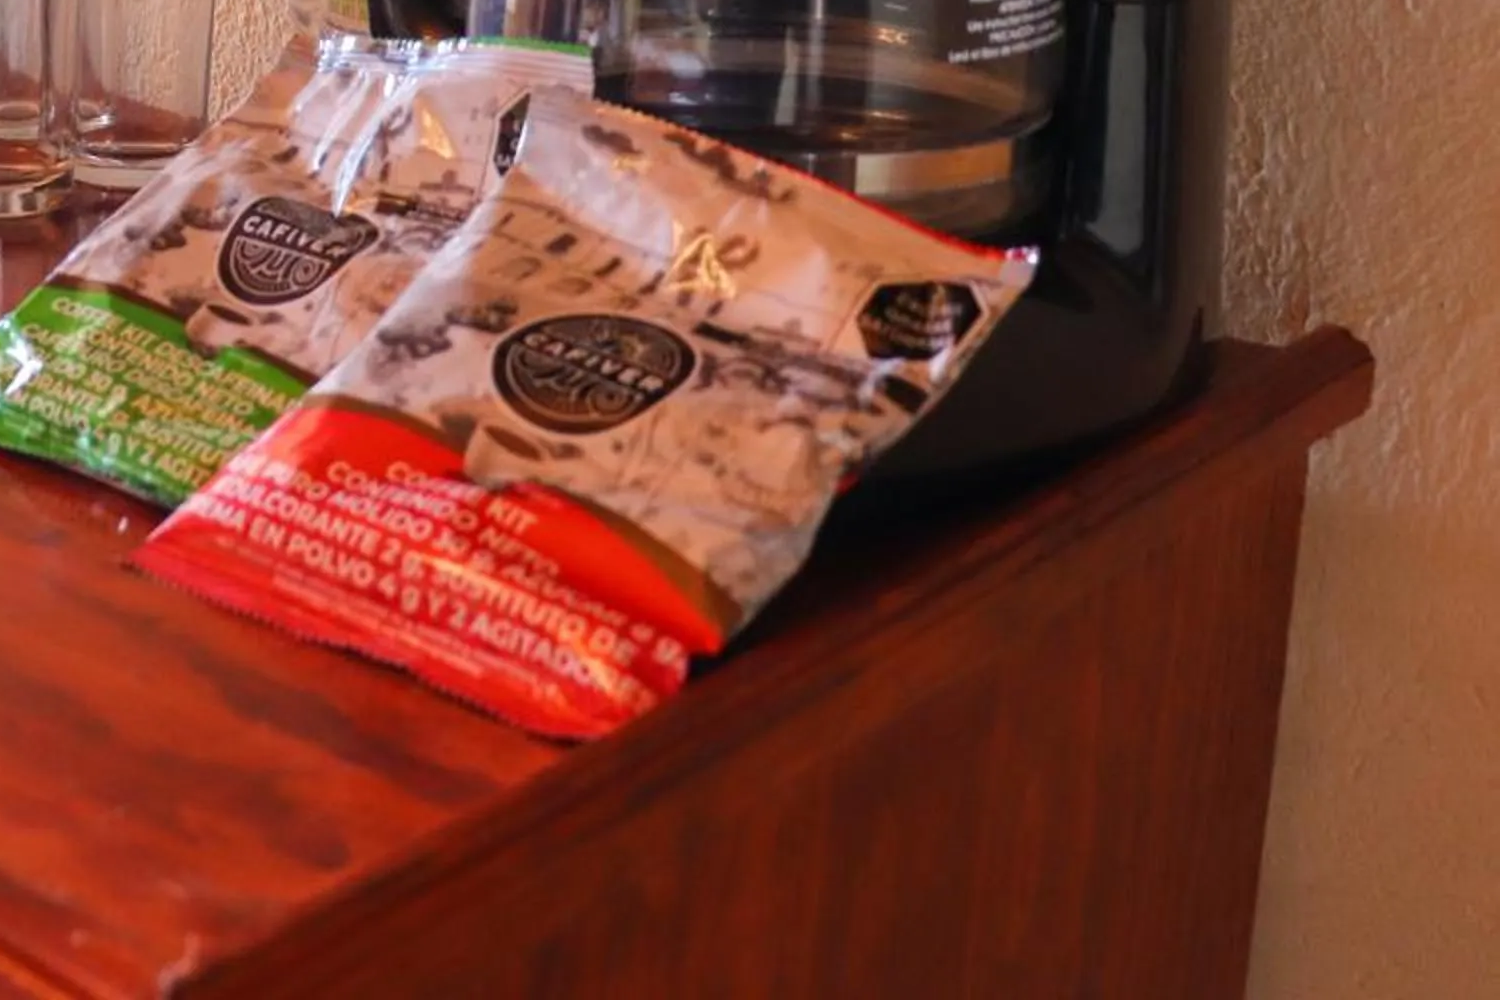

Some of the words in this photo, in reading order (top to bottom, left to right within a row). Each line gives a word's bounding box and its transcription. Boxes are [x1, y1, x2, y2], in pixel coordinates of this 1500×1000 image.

[120, 323, 160, 349] KIT
[523, 331, 664, 393] CAFIVER
[76, 323, 195, 388] CONTENIDO
[195, 379, 254, 416] NETO
[326, 459, 480, 533] CONTENIDO
[327, 490, 435, 542] MOLIDO
[485, 497, 540, 537] KIT
[249, 514, 288, 550] EN
[286, 532, 375, 590] POLVO
[376, 572, 398, 599] 4
